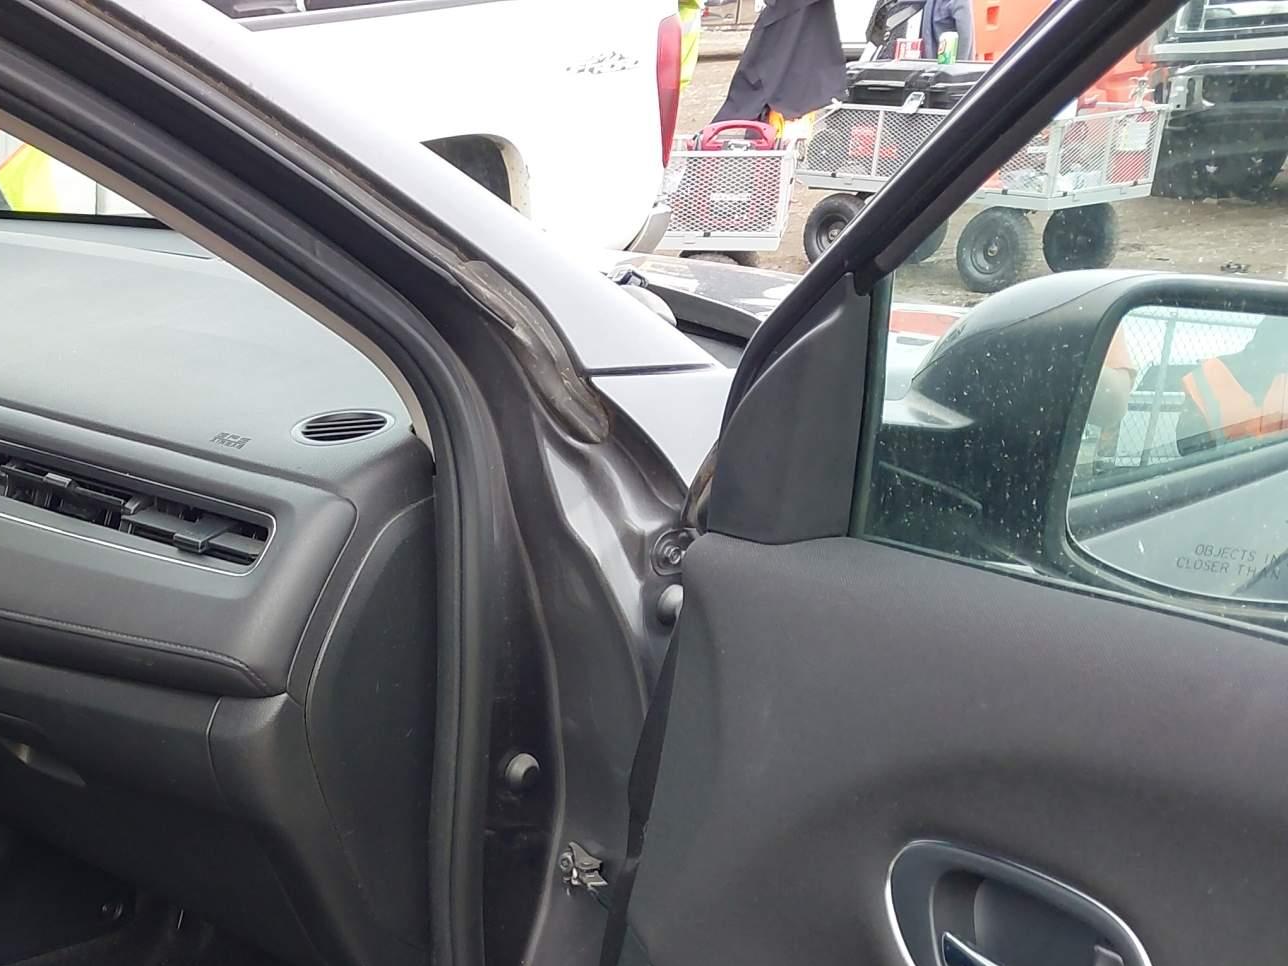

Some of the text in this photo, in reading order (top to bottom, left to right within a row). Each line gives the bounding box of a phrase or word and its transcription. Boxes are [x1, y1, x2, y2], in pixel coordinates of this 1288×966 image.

[1195, 544, 1257, 562] OBJECTS
[1176, 557, 1282, 580] CLOSER THAN
